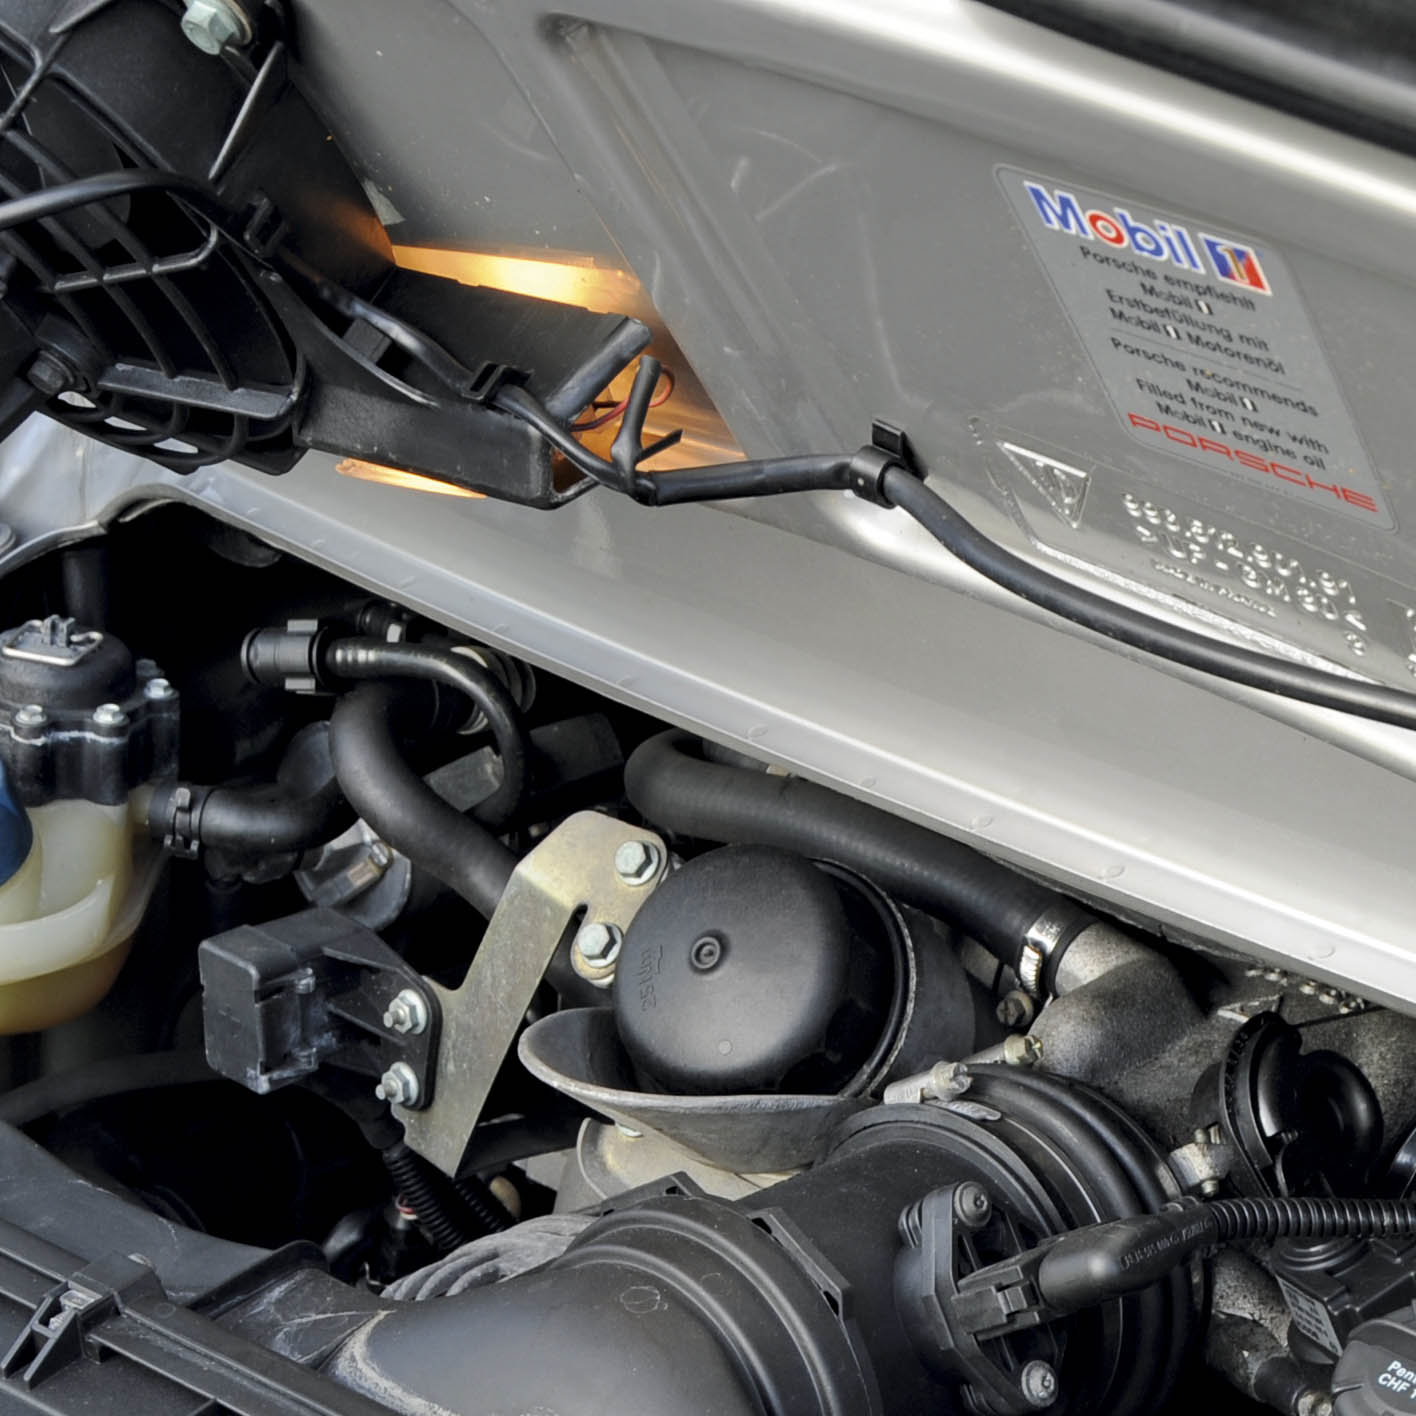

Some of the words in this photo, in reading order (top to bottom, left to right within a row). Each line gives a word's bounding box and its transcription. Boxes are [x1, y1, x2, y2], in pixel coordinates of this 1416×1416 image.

[1025, 182, 1204, 273] Mobil
[1080, 246, 1157, 280] Porsche
[1164, 274, 1256, 312] empfiehlt
[1140, 282, 1193, 309] Mobil
[1105, 288, 1232, 342] Erstbefüllung
[1238, 333, 1269, 351] mit
[1109, 307, 1161, 334] Mobil
[1186, 331, 1286, 375] Motorenöl
[1110, 337, 1186, 372] Porsche
[1193, 367, 1319, 417] recommends
[1186, 379, 1237, 406] Mobil
[1136, 378, 1186, 405] Filled
[1190, 397, 1235, 422] from
[1241, 416, 1280, 437] new
[1287, 432, 1329, 454] with
[1155, 401, 1207, 428] Mobil
[1233, 429, 1297, 460] engine
[1303, 454, 1326, 471] oil
[1128, 412, 1378, 512] PORSCHE
[1377, 1373, 1410, 1395] CHF
